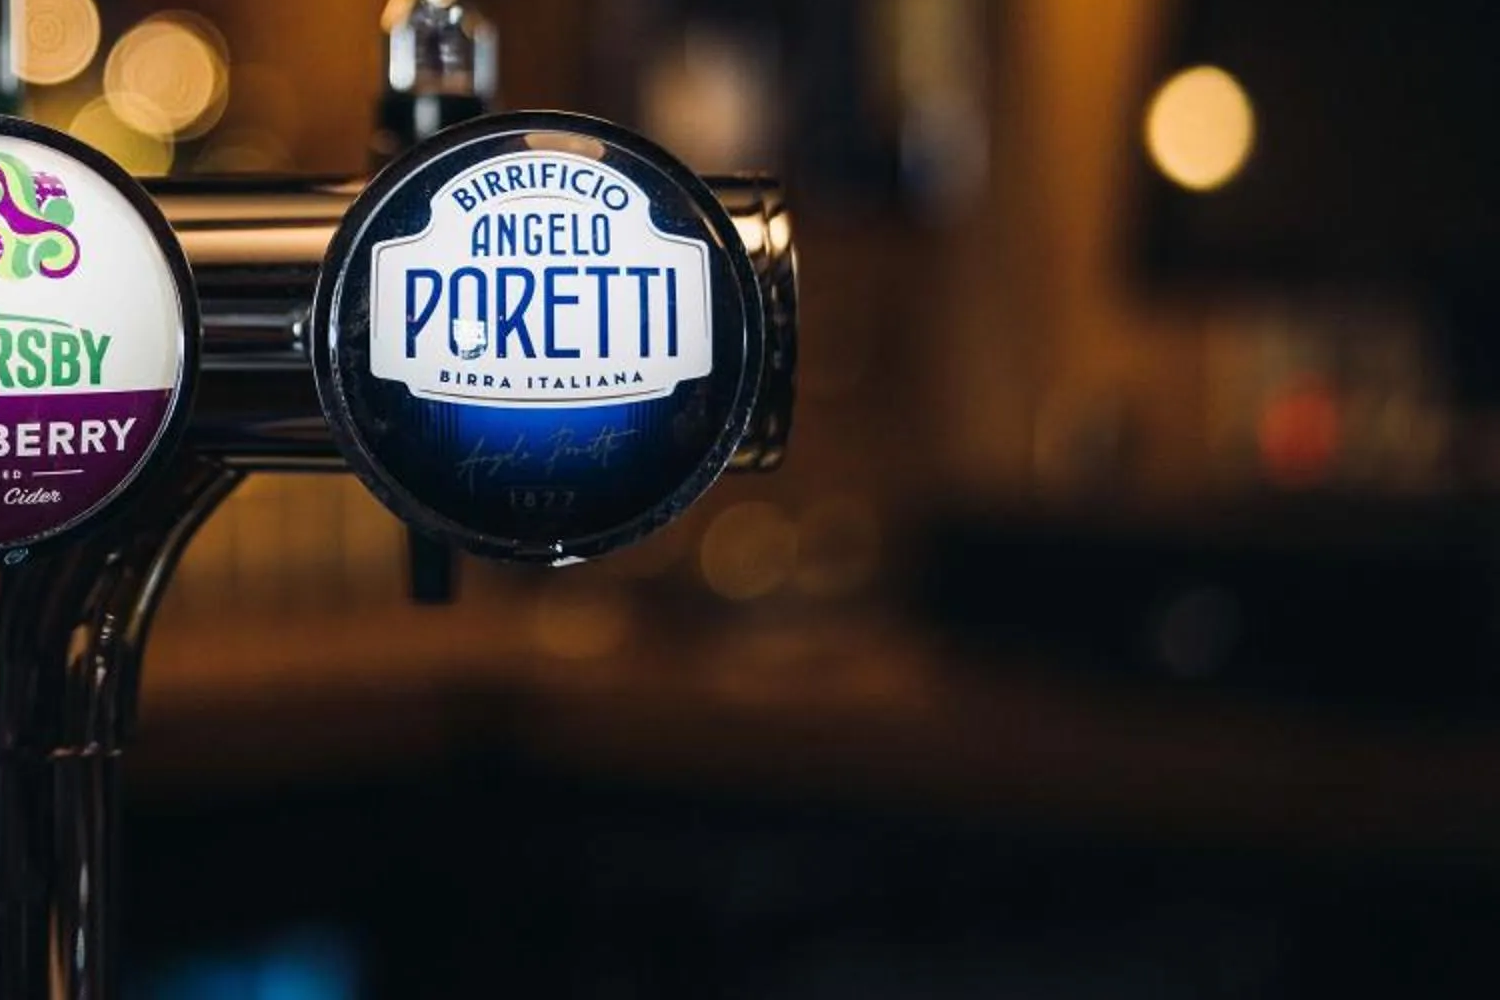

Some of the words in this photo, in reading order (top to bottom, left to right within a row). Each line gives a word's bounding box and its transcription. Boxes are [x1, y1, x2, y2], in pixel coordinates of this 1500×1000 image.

[451, 163, 629, 213] BIRRIFICIO
[472, 213, 611, 257] ANGELO
[406, 267, 678, 359] PORETTI
[439, 371, 511, 389] BIRRA
[527, 372, 644, 389] ITALIANA
[3, 487, 61, 505] Cider
